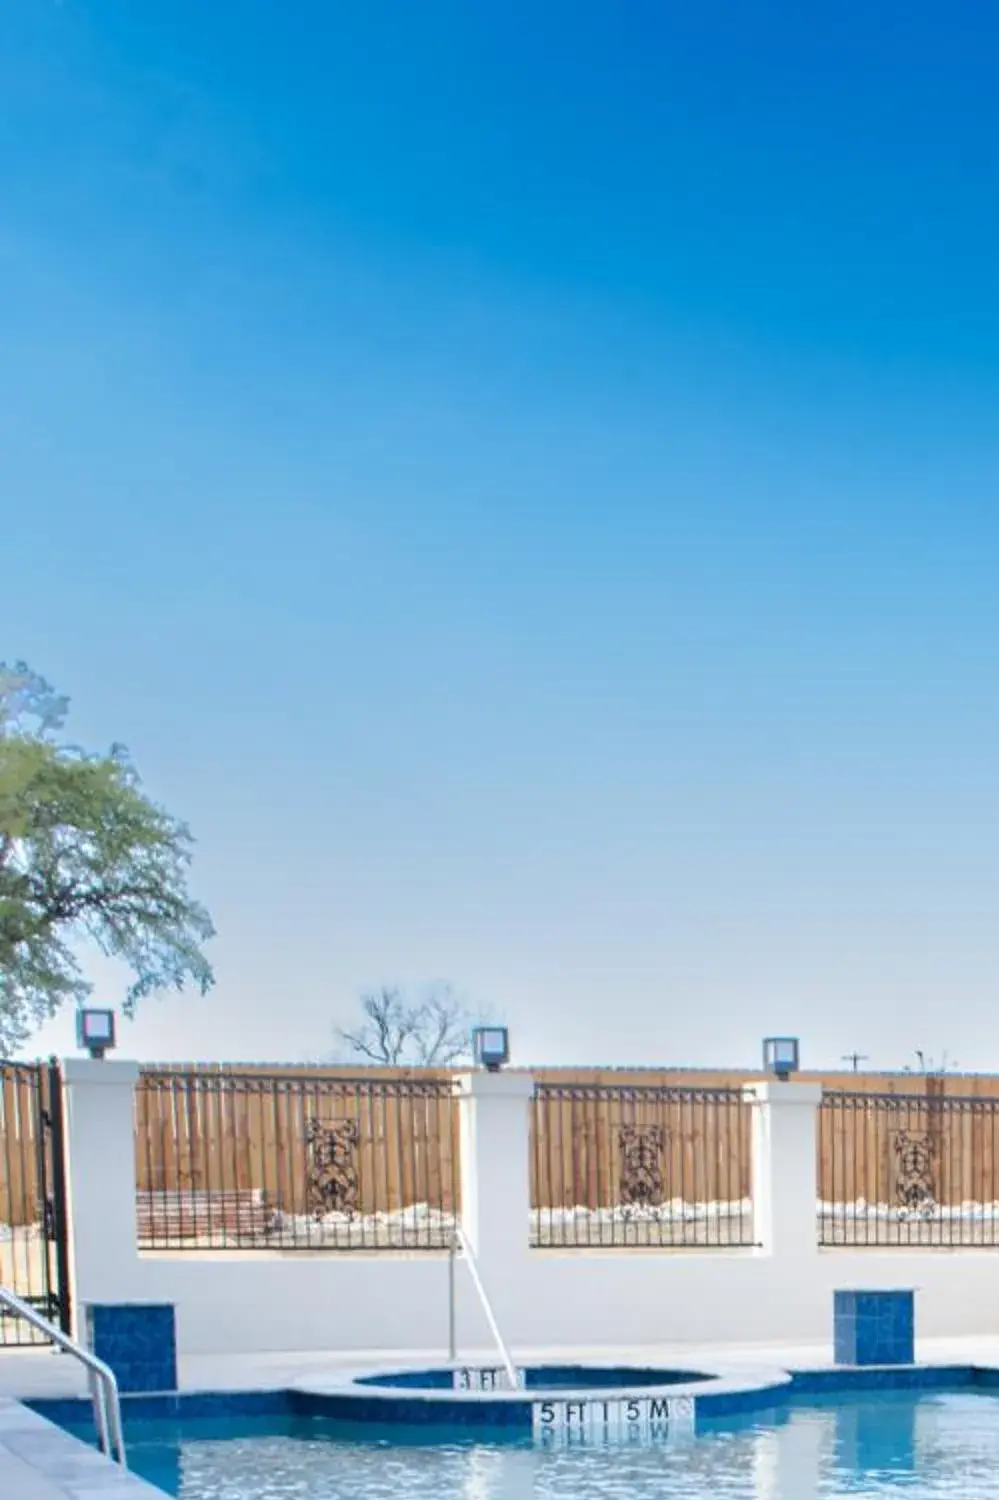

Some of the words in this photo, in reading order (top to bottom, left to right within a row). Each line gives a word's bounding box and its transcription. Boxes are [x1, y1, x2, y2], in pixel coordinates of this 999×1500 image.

[480, 1368, 497, 1390] FT
[541, 1401, 555, 1423] 5
[566, 1402, 586, 1423] FT
[626, 1400, 641, 1421] 5
[649, 1399, 669, 1420] M
